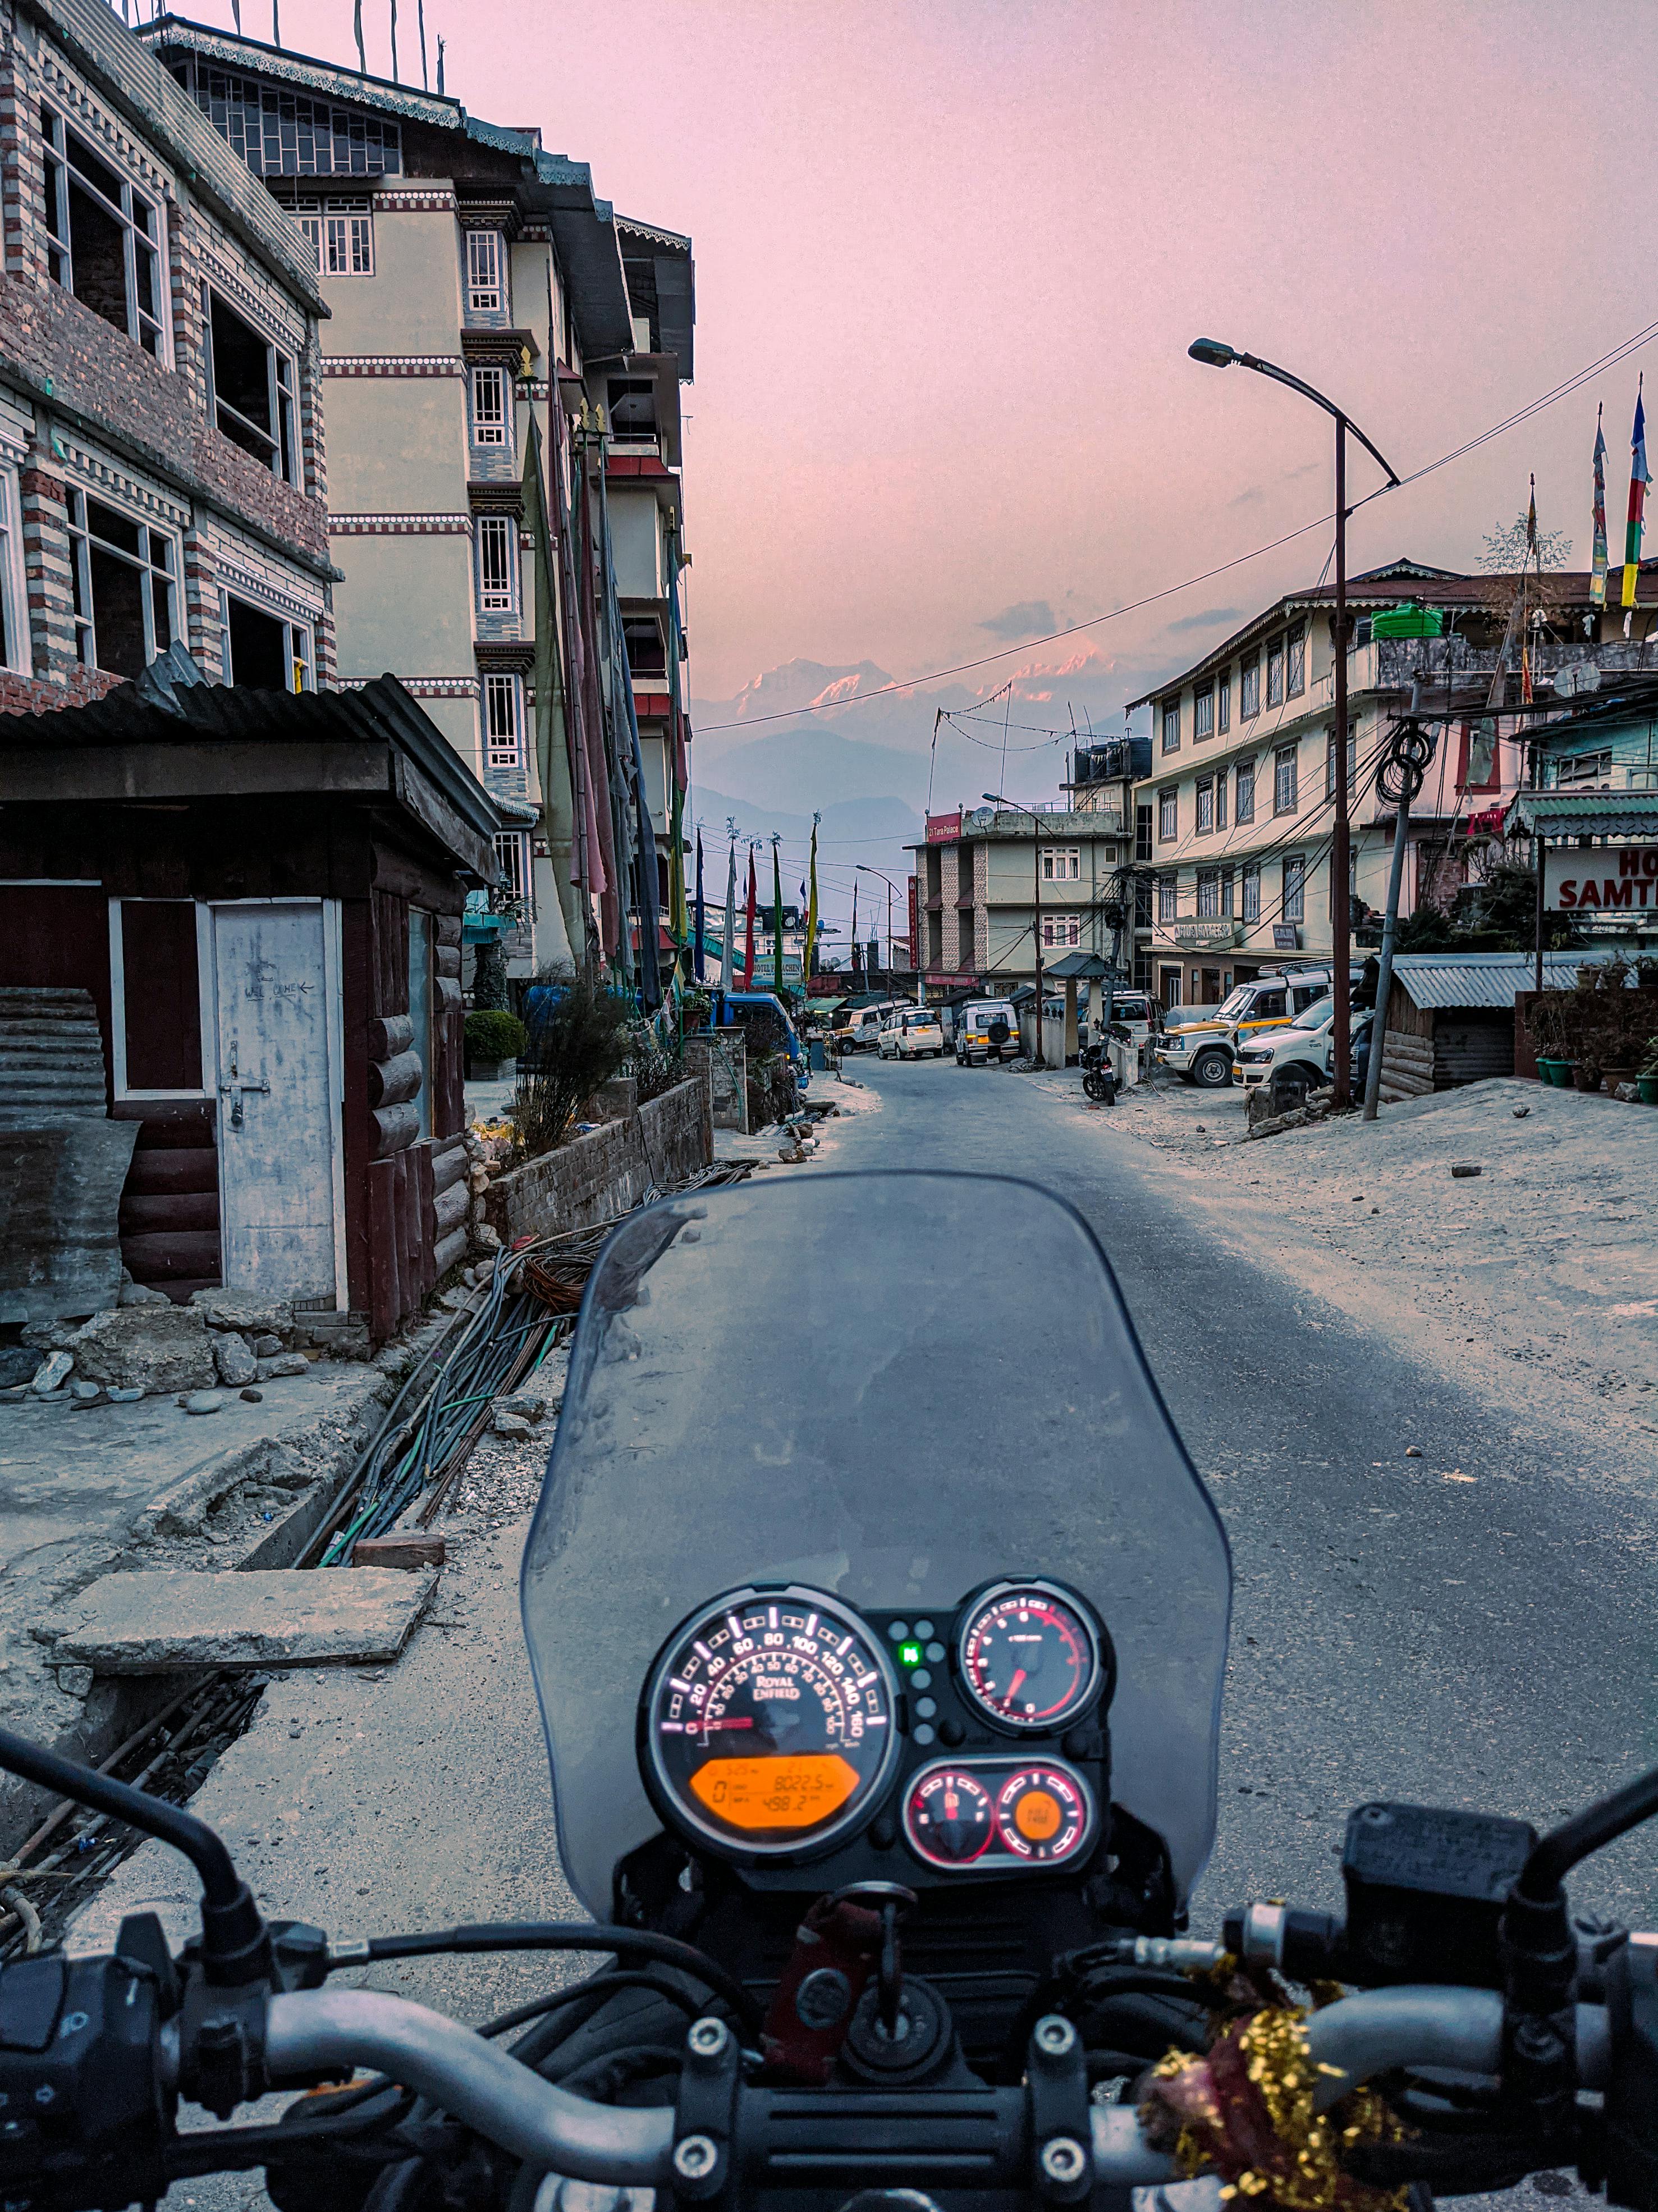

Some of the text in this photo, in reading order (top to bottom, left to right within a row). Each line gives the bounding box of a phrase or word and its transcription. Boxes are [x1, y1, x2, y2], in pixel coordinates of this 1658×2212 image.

[934, 827, 943, 835] Tara
[944, 825, 959, 834] Palace
[1559, 879, 1658, 907] SAMT
[997, 1617, 1007, 1629] 5
[904, 1647, 918, 1662] N
[685, 1633, 864, 1738] 0 20 40 60 80 100 120 140 160
[756, 1676, 795, 1688] ROYAL
[721, 1685, 735, 1699] 20
[735, 1671, 748, 1684] 30
[751, 1663, 764, 1674] 40
[767, 1661, 781, 1671] 50
[784, 1663, 799, 1674] 60
[813, 1682, 826, 1697] 80
[826, 1715, 835, 1735] 100
[753, 1688, 800, 1702] ENFIELD
[1025, 1703, 1036, 1713] 0
[712, 1780, 728, 1803] 0
[919, 1811, 984, 1824] E F
